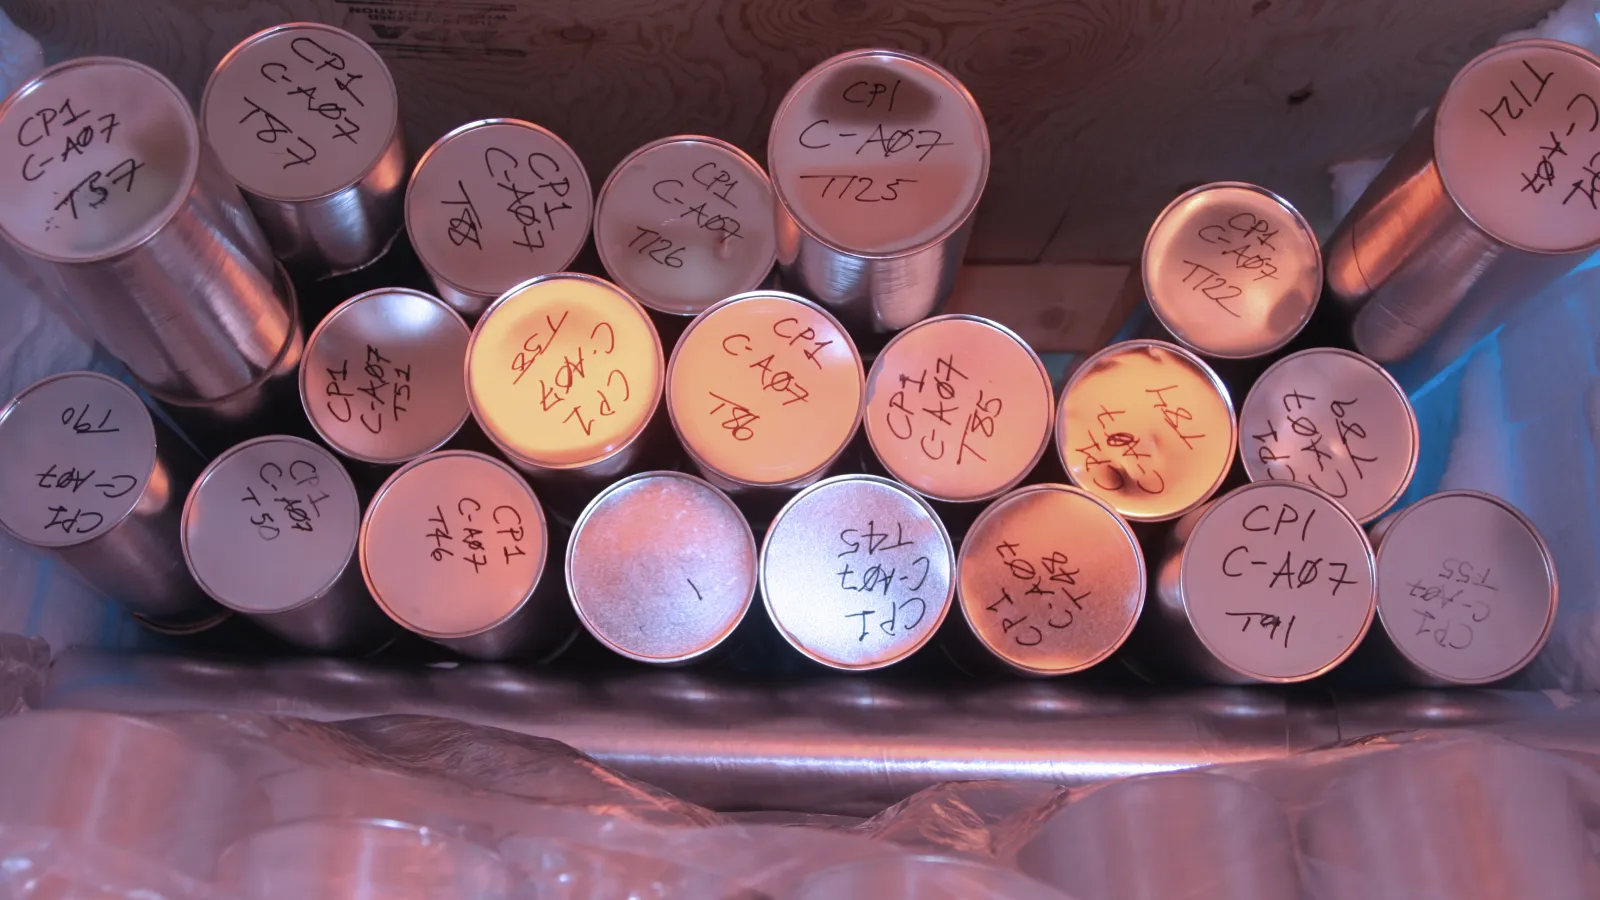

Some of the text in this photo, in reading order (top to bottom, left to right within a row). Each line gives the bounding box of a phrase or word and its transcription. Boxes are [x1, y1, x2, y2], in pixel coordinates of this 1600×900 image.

[291, 37, 364, 106] CP1
[843, 80, 900, 112] CP1
[1479, 60, 1554, 136] T121
[18, 99, 90, 147] CP1
[239, 97, 317, 170] T87
[528, 153, 572, 231] CP1
[692, 162, 737, 209] CP1
[800, 175, 918, 202] T125
[628, 226, 684, 268] T126
[1228, 213, 1279, 251] CP1
[1182, 260, 1242, 317] T122
[511, 310, 569, 384] T58
[772, 317, 833, 370] CP1
[61, 404, 120, 433] T90
[326, 360, 354, 422] CP1
[394, 364, 410, 421] T51
[562, 369, 629, 436] CP1
[709, 391, 761, 441] T86
[887, 369, 927, 440] CP1
[1145, 385, 1205, 449] T84
[956, 390, 1002, 464] T85
[1331, 398, 1378, 479] T89
[289, 460, 330, 517] CP1
[1076, 430, 1124, 491] CP1
[44, 506, 104, 534] CP1
[427, 505, 454, 563] T46
[493, 504, 526, 565] CP1
[838, 520, 913, 558] T45
[1242, 504, 1316, 541] CP1
[1041, 551, 1091, 611] T48
[845, 598, 926, 642] CP1
[986, 588, 1042, 646] CP1
[1412, 607, 1474, 651] CP1
